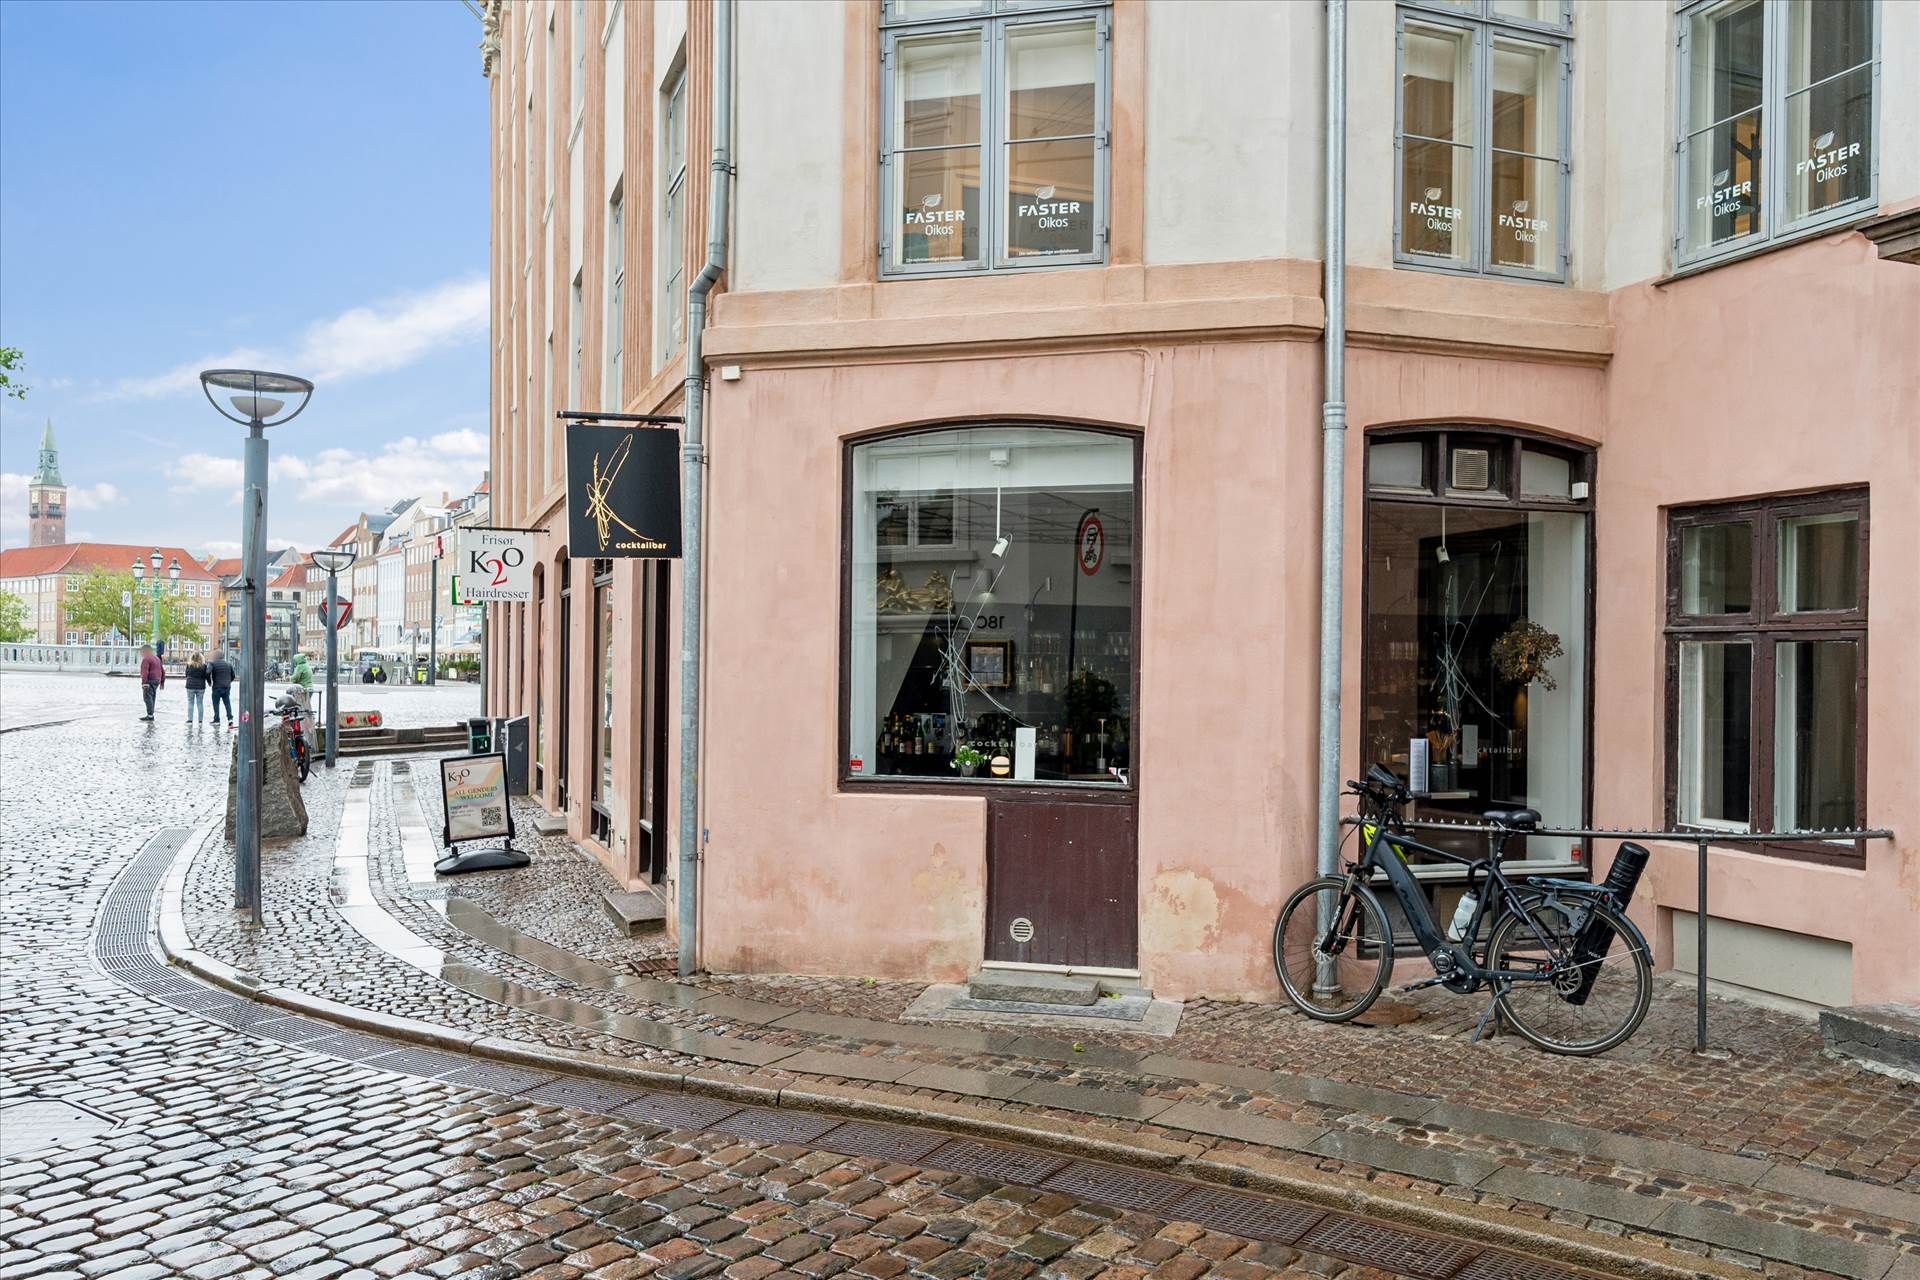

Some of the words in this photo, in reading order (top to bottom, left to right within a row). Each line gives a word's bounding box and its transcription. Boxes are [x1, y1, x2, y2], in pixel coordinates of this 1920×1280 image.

[1796, 142, 1861, 176] FASTER
[1816, 164, 1848, 183] Oikos
[1696, 180, 1752, 210] FASTER
[1018, 201, 1080, 217] FASTER
[1410, 202, 1463, 220] FASTER
[1714, 200, 1741, 217] Oikos
[905, 209, 966, 225] FASTER
[1038, 216, 1068, 229] Oikos
[1427, 217, 1453, 232] Oikos
[1498, 214, 1549, 232] FASTER
[925, 224, 954, 236] Oikos
[1515, 230, 1538, 243] Oikos
[482, 534, 515, 546] Frisør
[615, 540, 667, 550] cocktailbar
[469, 547, 525, 587] K2O
[466, 587, 530, 599] Hairdresser
